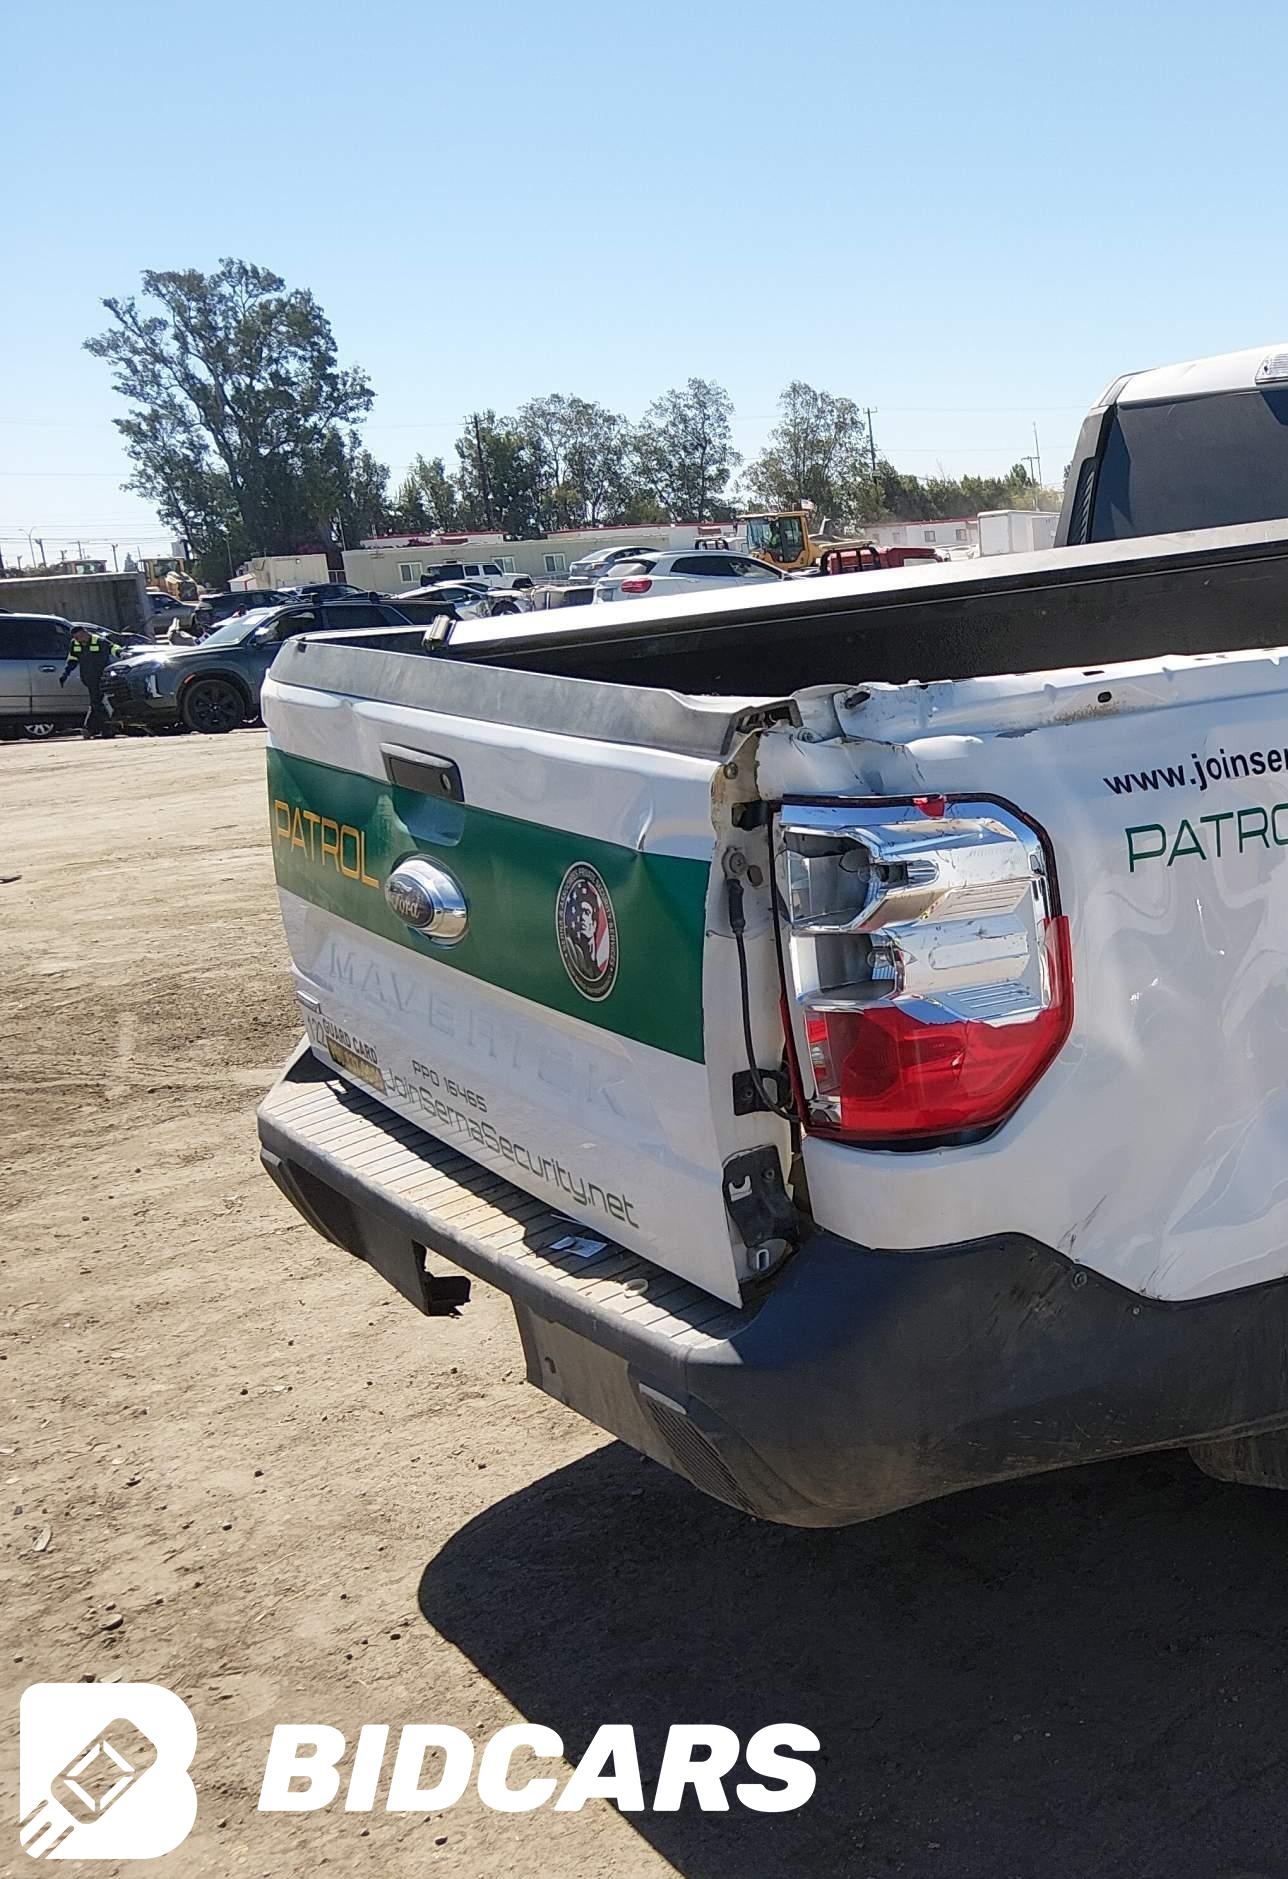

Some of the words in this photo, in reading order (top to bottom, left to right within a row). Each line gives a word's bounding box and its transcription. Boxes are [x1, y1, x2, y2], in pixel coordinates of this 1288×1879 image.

[275, 799, 380, 888] PATROL
[322, 1018, 352, 1049] GUARD
[412, 1059, 440, 1088] PPO
[385, 1068, 639, 1229] JoinSernaSecurity.net
